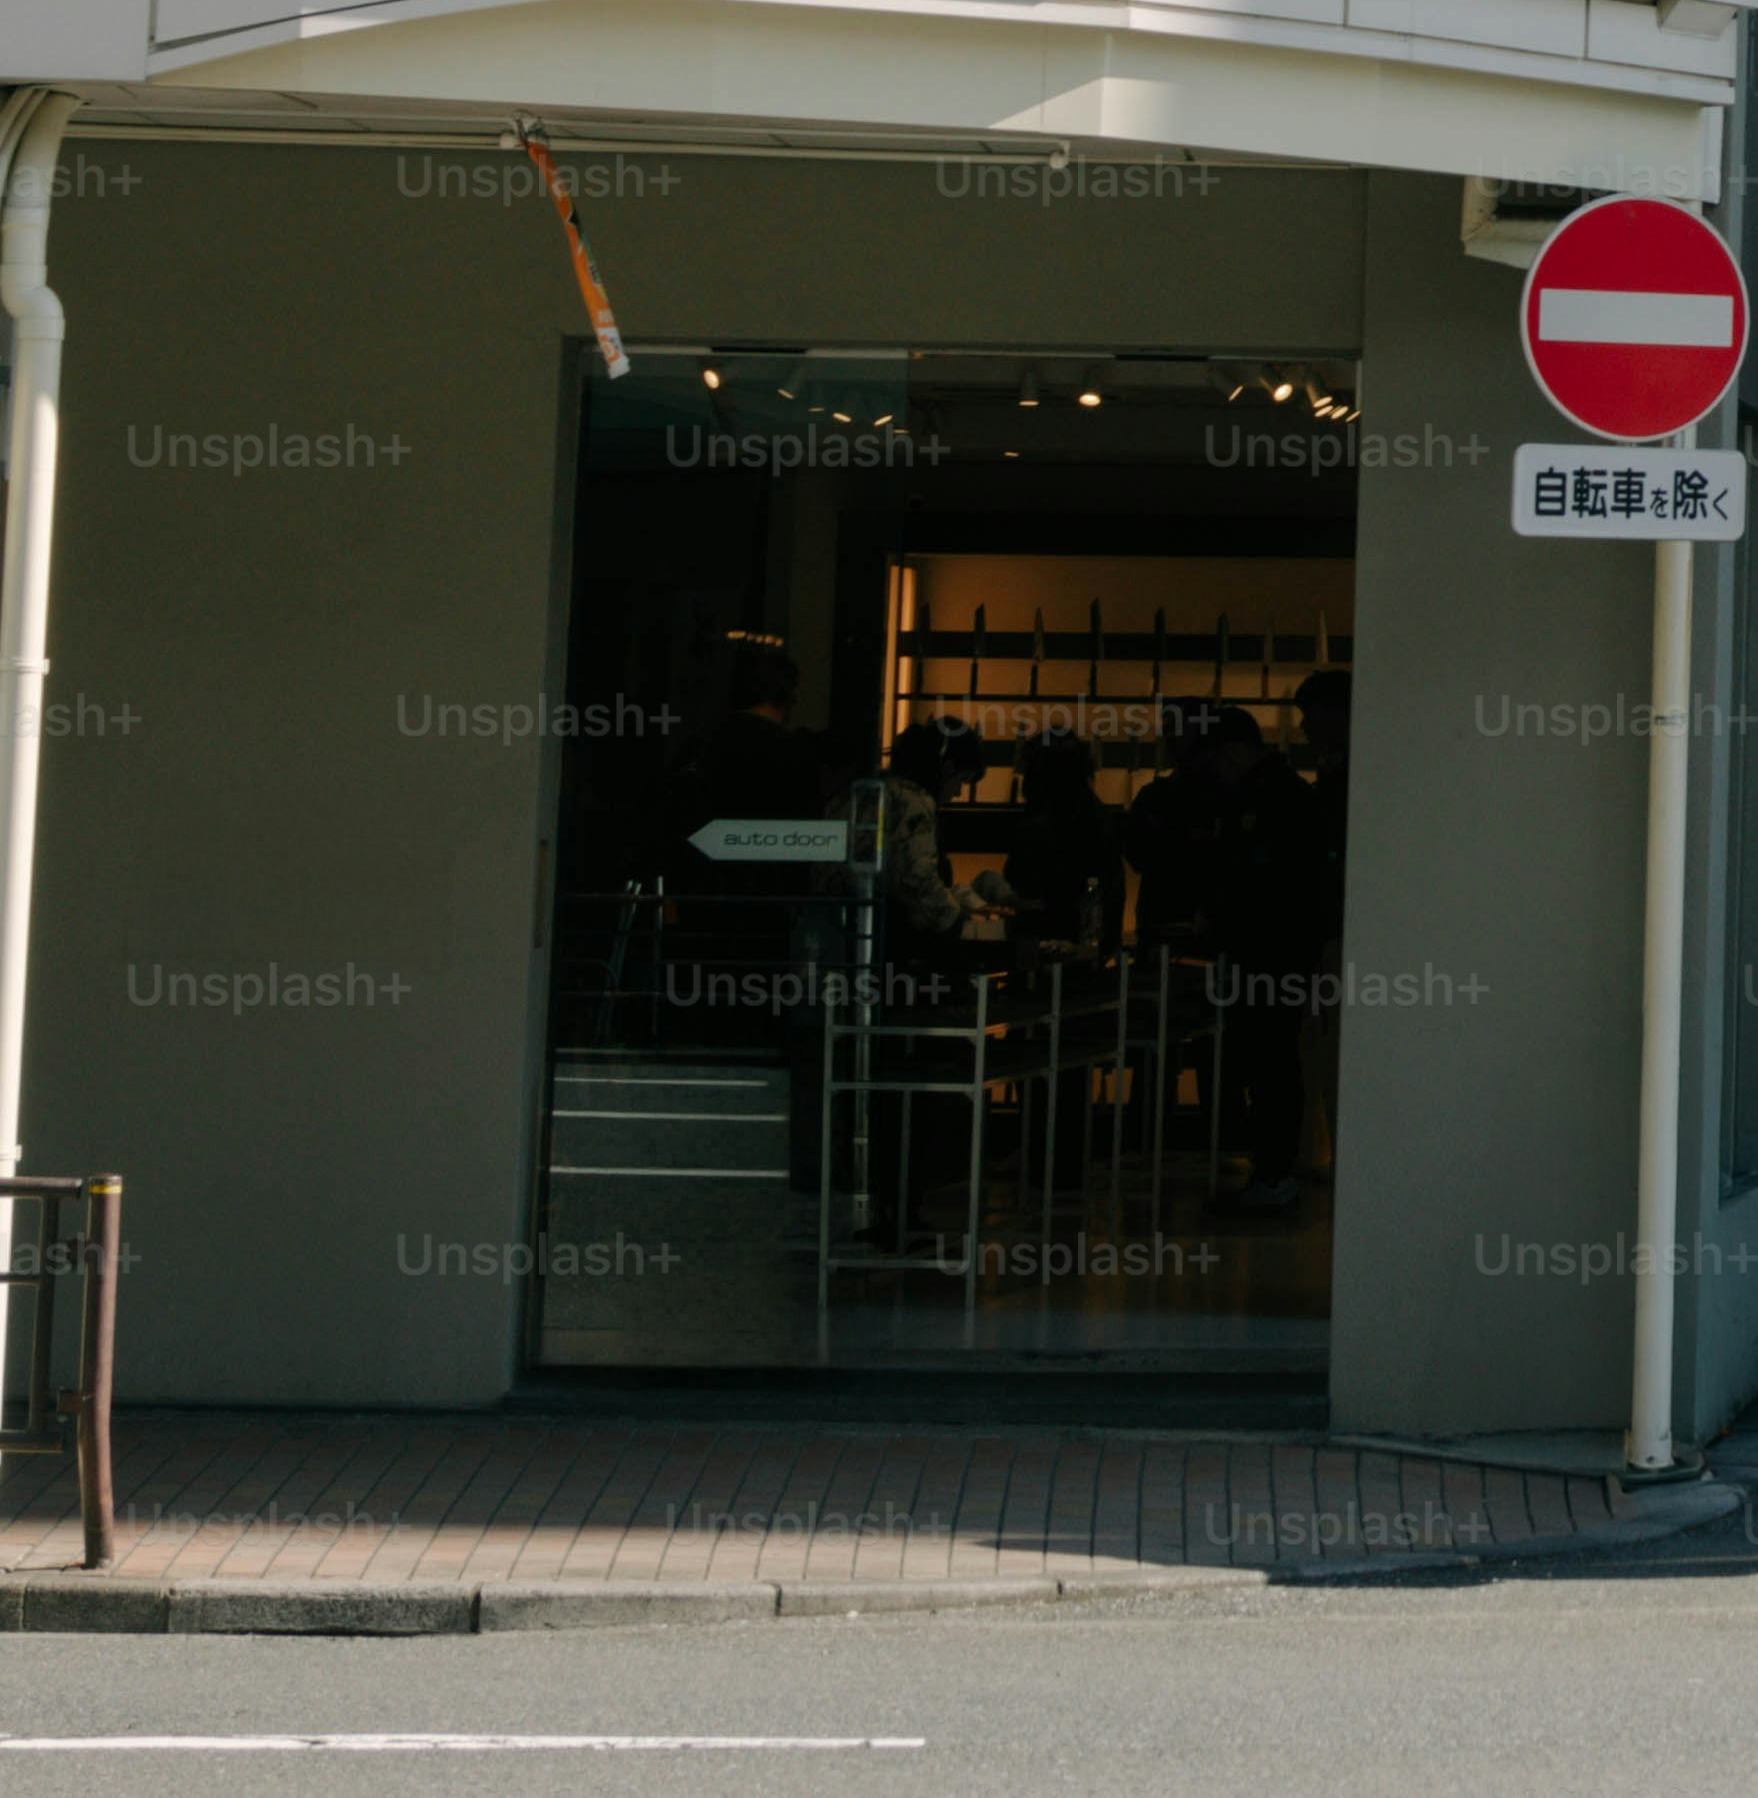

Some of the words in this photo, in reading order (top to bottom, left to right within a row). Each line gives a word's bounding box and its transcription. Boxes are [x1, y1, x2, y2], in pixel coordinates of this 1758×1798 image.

[1534, 467, 1729, 521] 自転車を除く
[723, 832, 778, 847] auto
[783, 831, 839, 847] door
